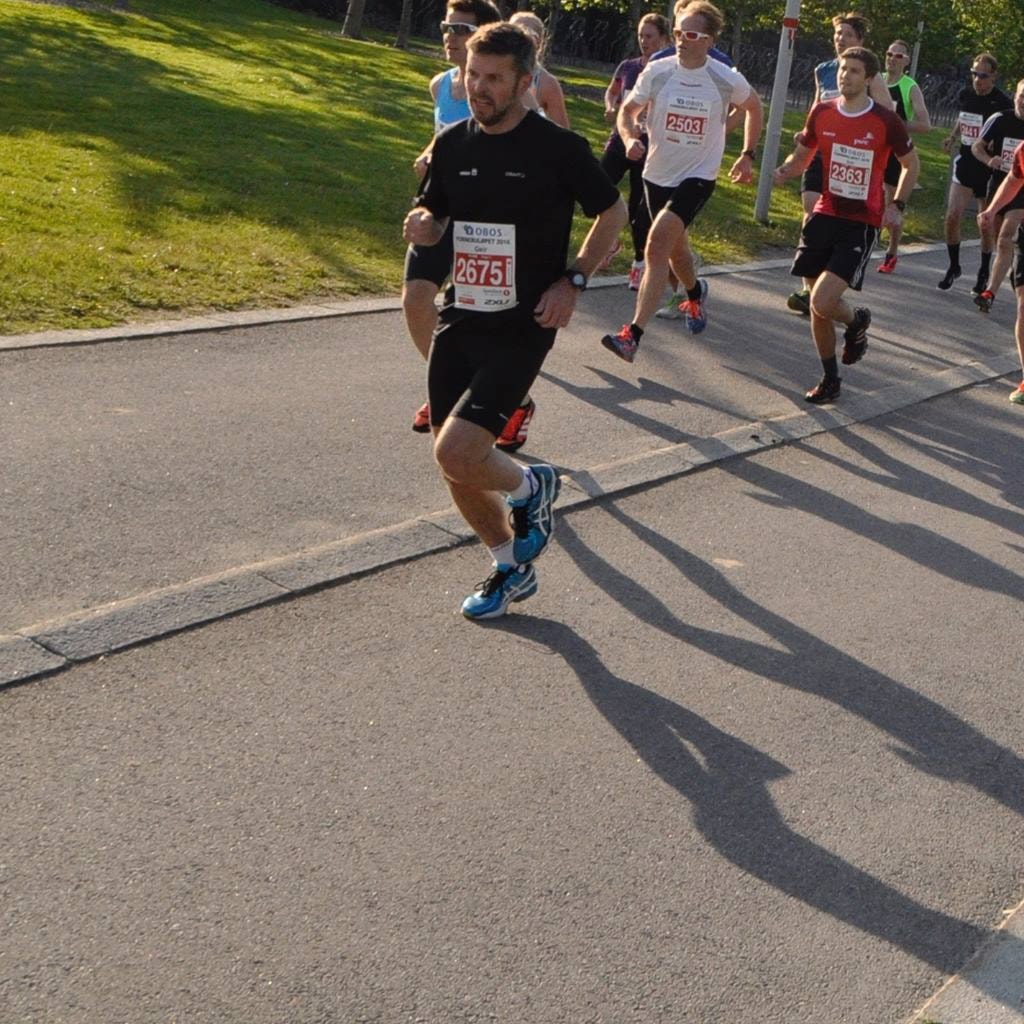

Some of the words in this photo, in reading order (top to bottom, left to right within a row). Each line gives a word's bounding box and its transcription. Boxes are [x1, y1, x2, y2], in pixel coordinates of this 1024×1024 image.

[667, 115, 702, 134] 2503
[831, 164, 863, 184] 2363
[475, 227, 502, 237] OBOS
[455, 257, 503, 286] 2675
